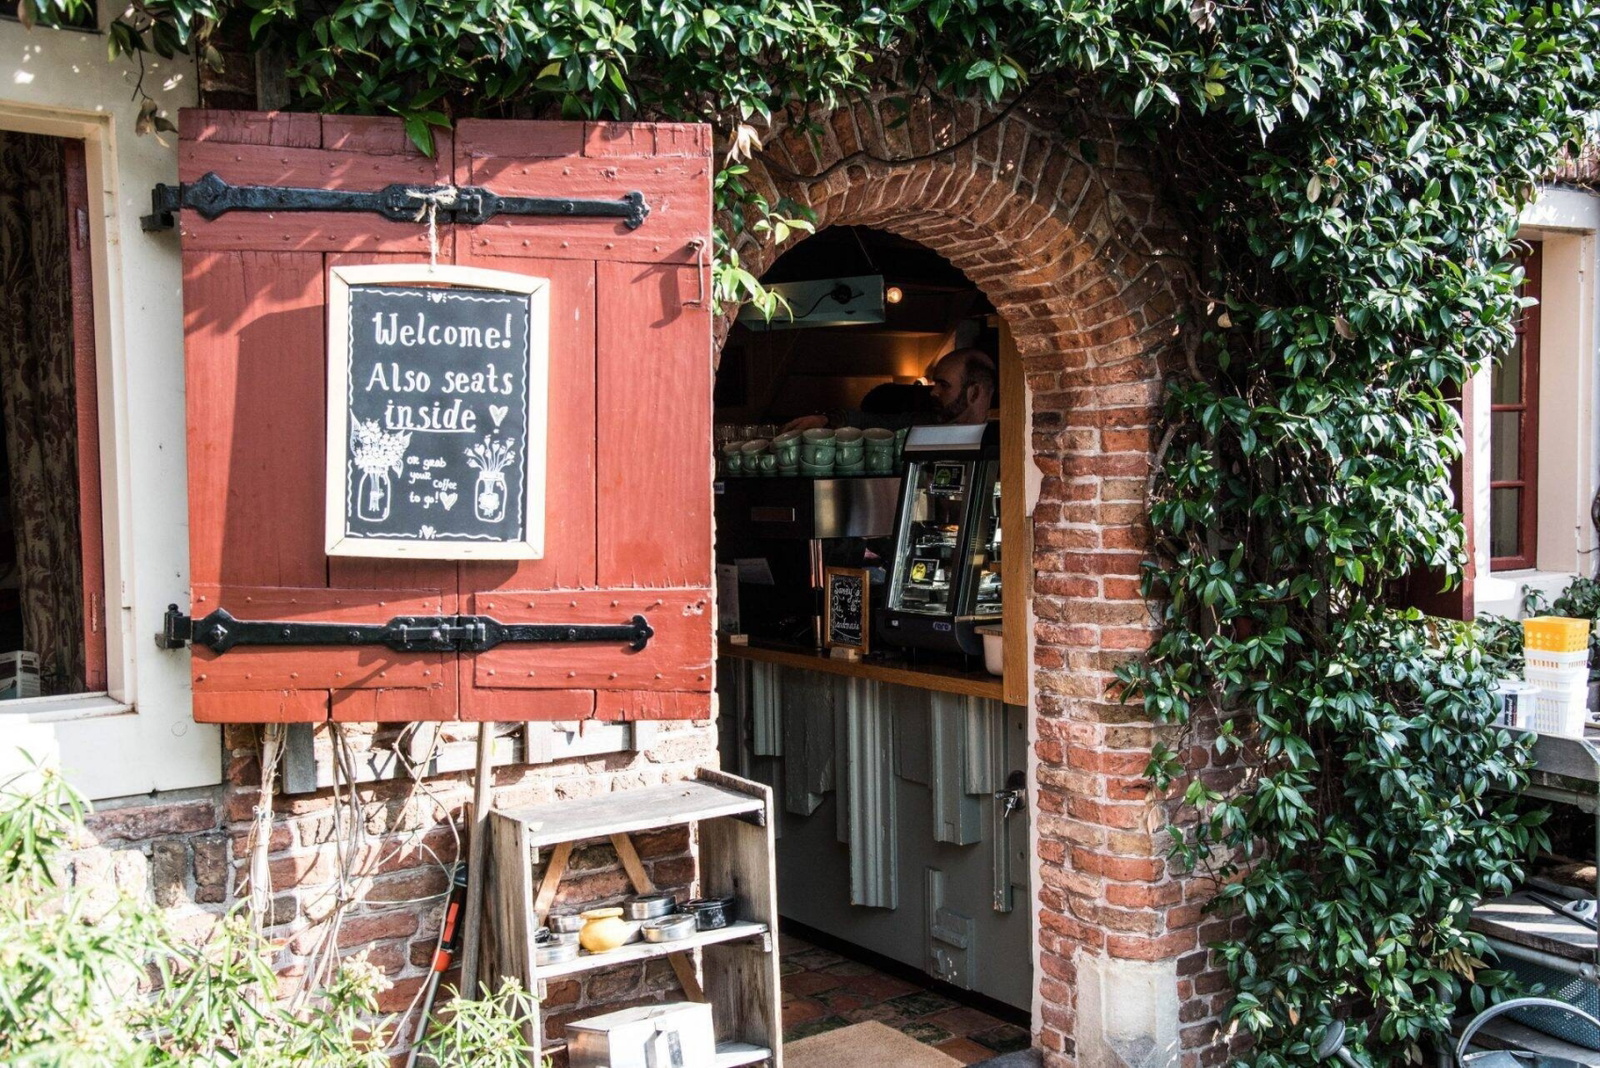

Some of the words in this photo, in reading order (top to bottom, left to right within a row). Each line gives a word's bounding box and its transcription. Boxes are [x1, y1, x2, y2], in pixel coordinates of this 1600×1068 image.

[372, 312, 512, 349] Welcome!
[365, 363, 431, 394] Also
[441, 363, 513, 395] seats
[385, 399, 476, 430] inside
[409, 491, 421, 503] to
[423, 491, 439, 509] go!
